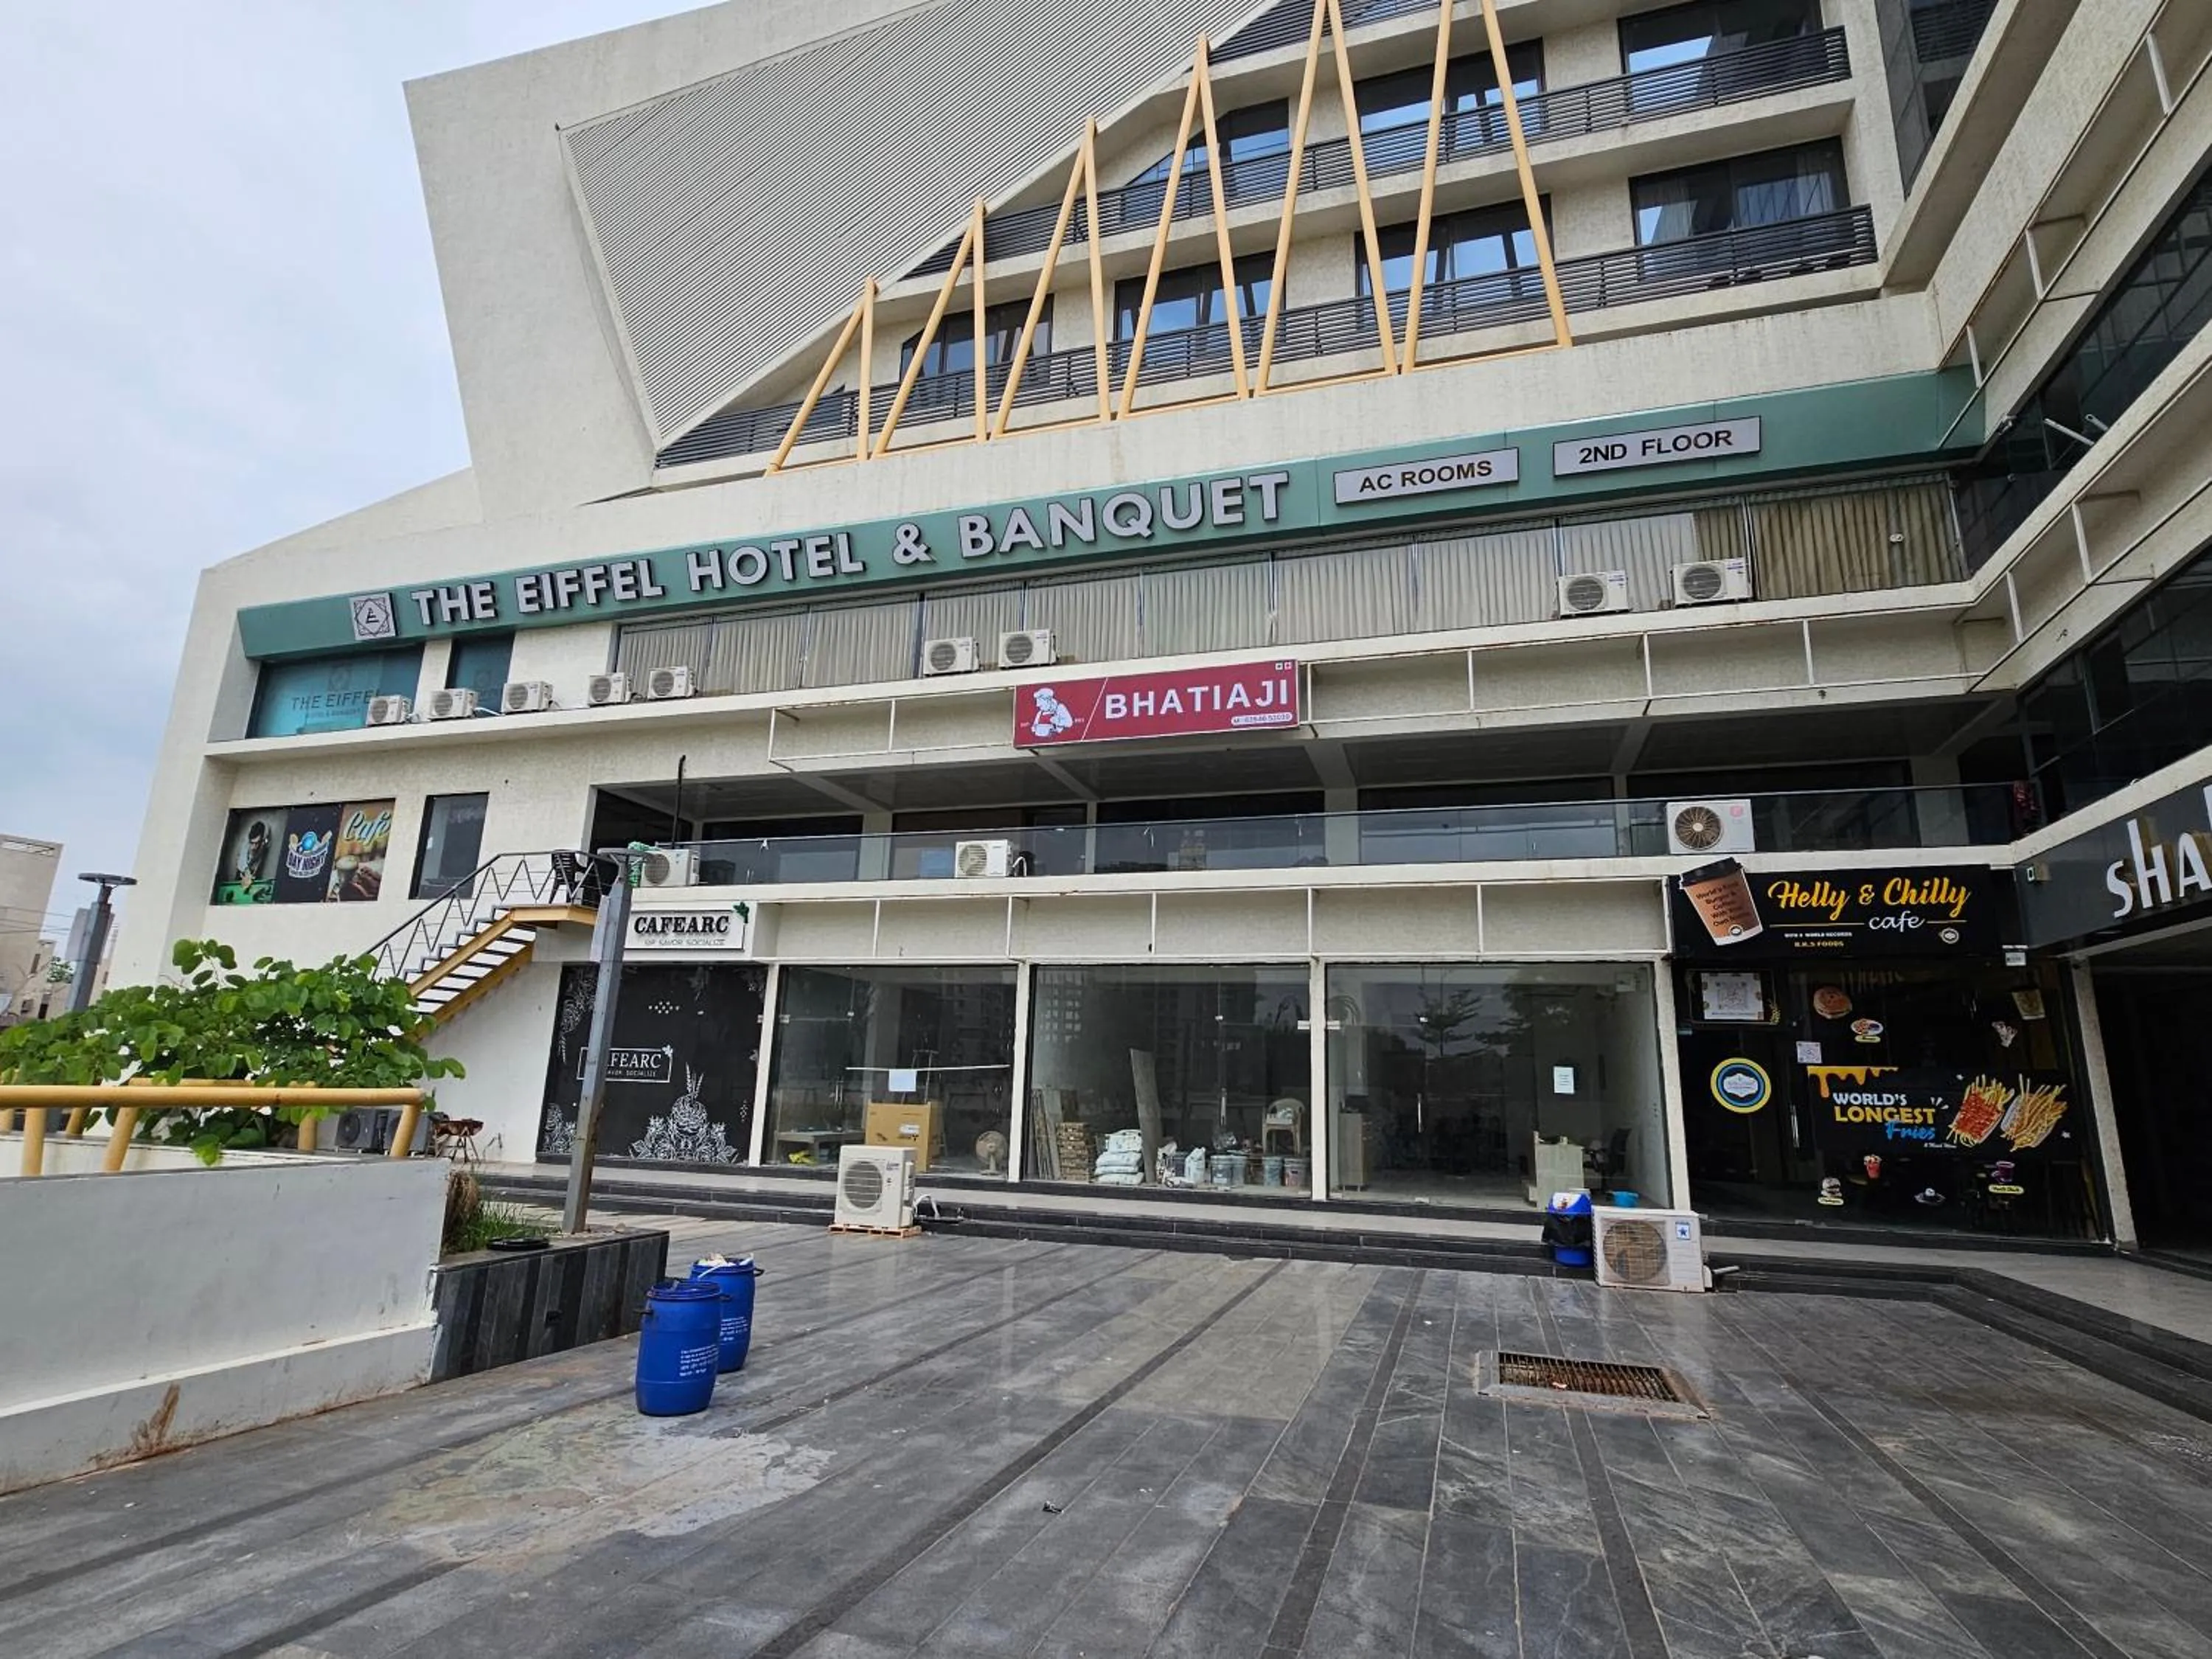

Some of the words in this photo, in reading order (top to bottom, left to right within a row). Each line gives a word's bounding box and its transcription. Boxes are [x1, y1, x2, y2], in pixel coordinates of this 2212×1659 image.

[1579, 443, 1627, 465] 2ND
[1641, 430, 1733, 456] FLOOR
[1359, 473, 1393, 493] AC
[1401, 460, 1492, 487] ROOMS
[411, 581, 498, 625] THE
[515, 558, 663, 614] EIFFEL
[686, 531, 867, 591] HOTEL
[892, 522, 936, 565] &
[958, 470, 1290, 560] BANQUET
[291, 695, 322, 710] THE
[1105, 679, 1288, 720] BHATIAJI
[1767, 880, 1851, 921] Helly
[1858, 884, 1875, 905] &
[1883, 876, 1971, 918] Chilly
[633, 915, 729, 934] CAFEARC
[1868, 909, 1926, 933] cafe
[608, 1052, 661, 1069] FEARC
[1833, 1092, 1907, 1105] WORLD'S
[1834, 1105, 1936, 1124] LONGEST
[1885, 1119, 1935, 1141] Fries
